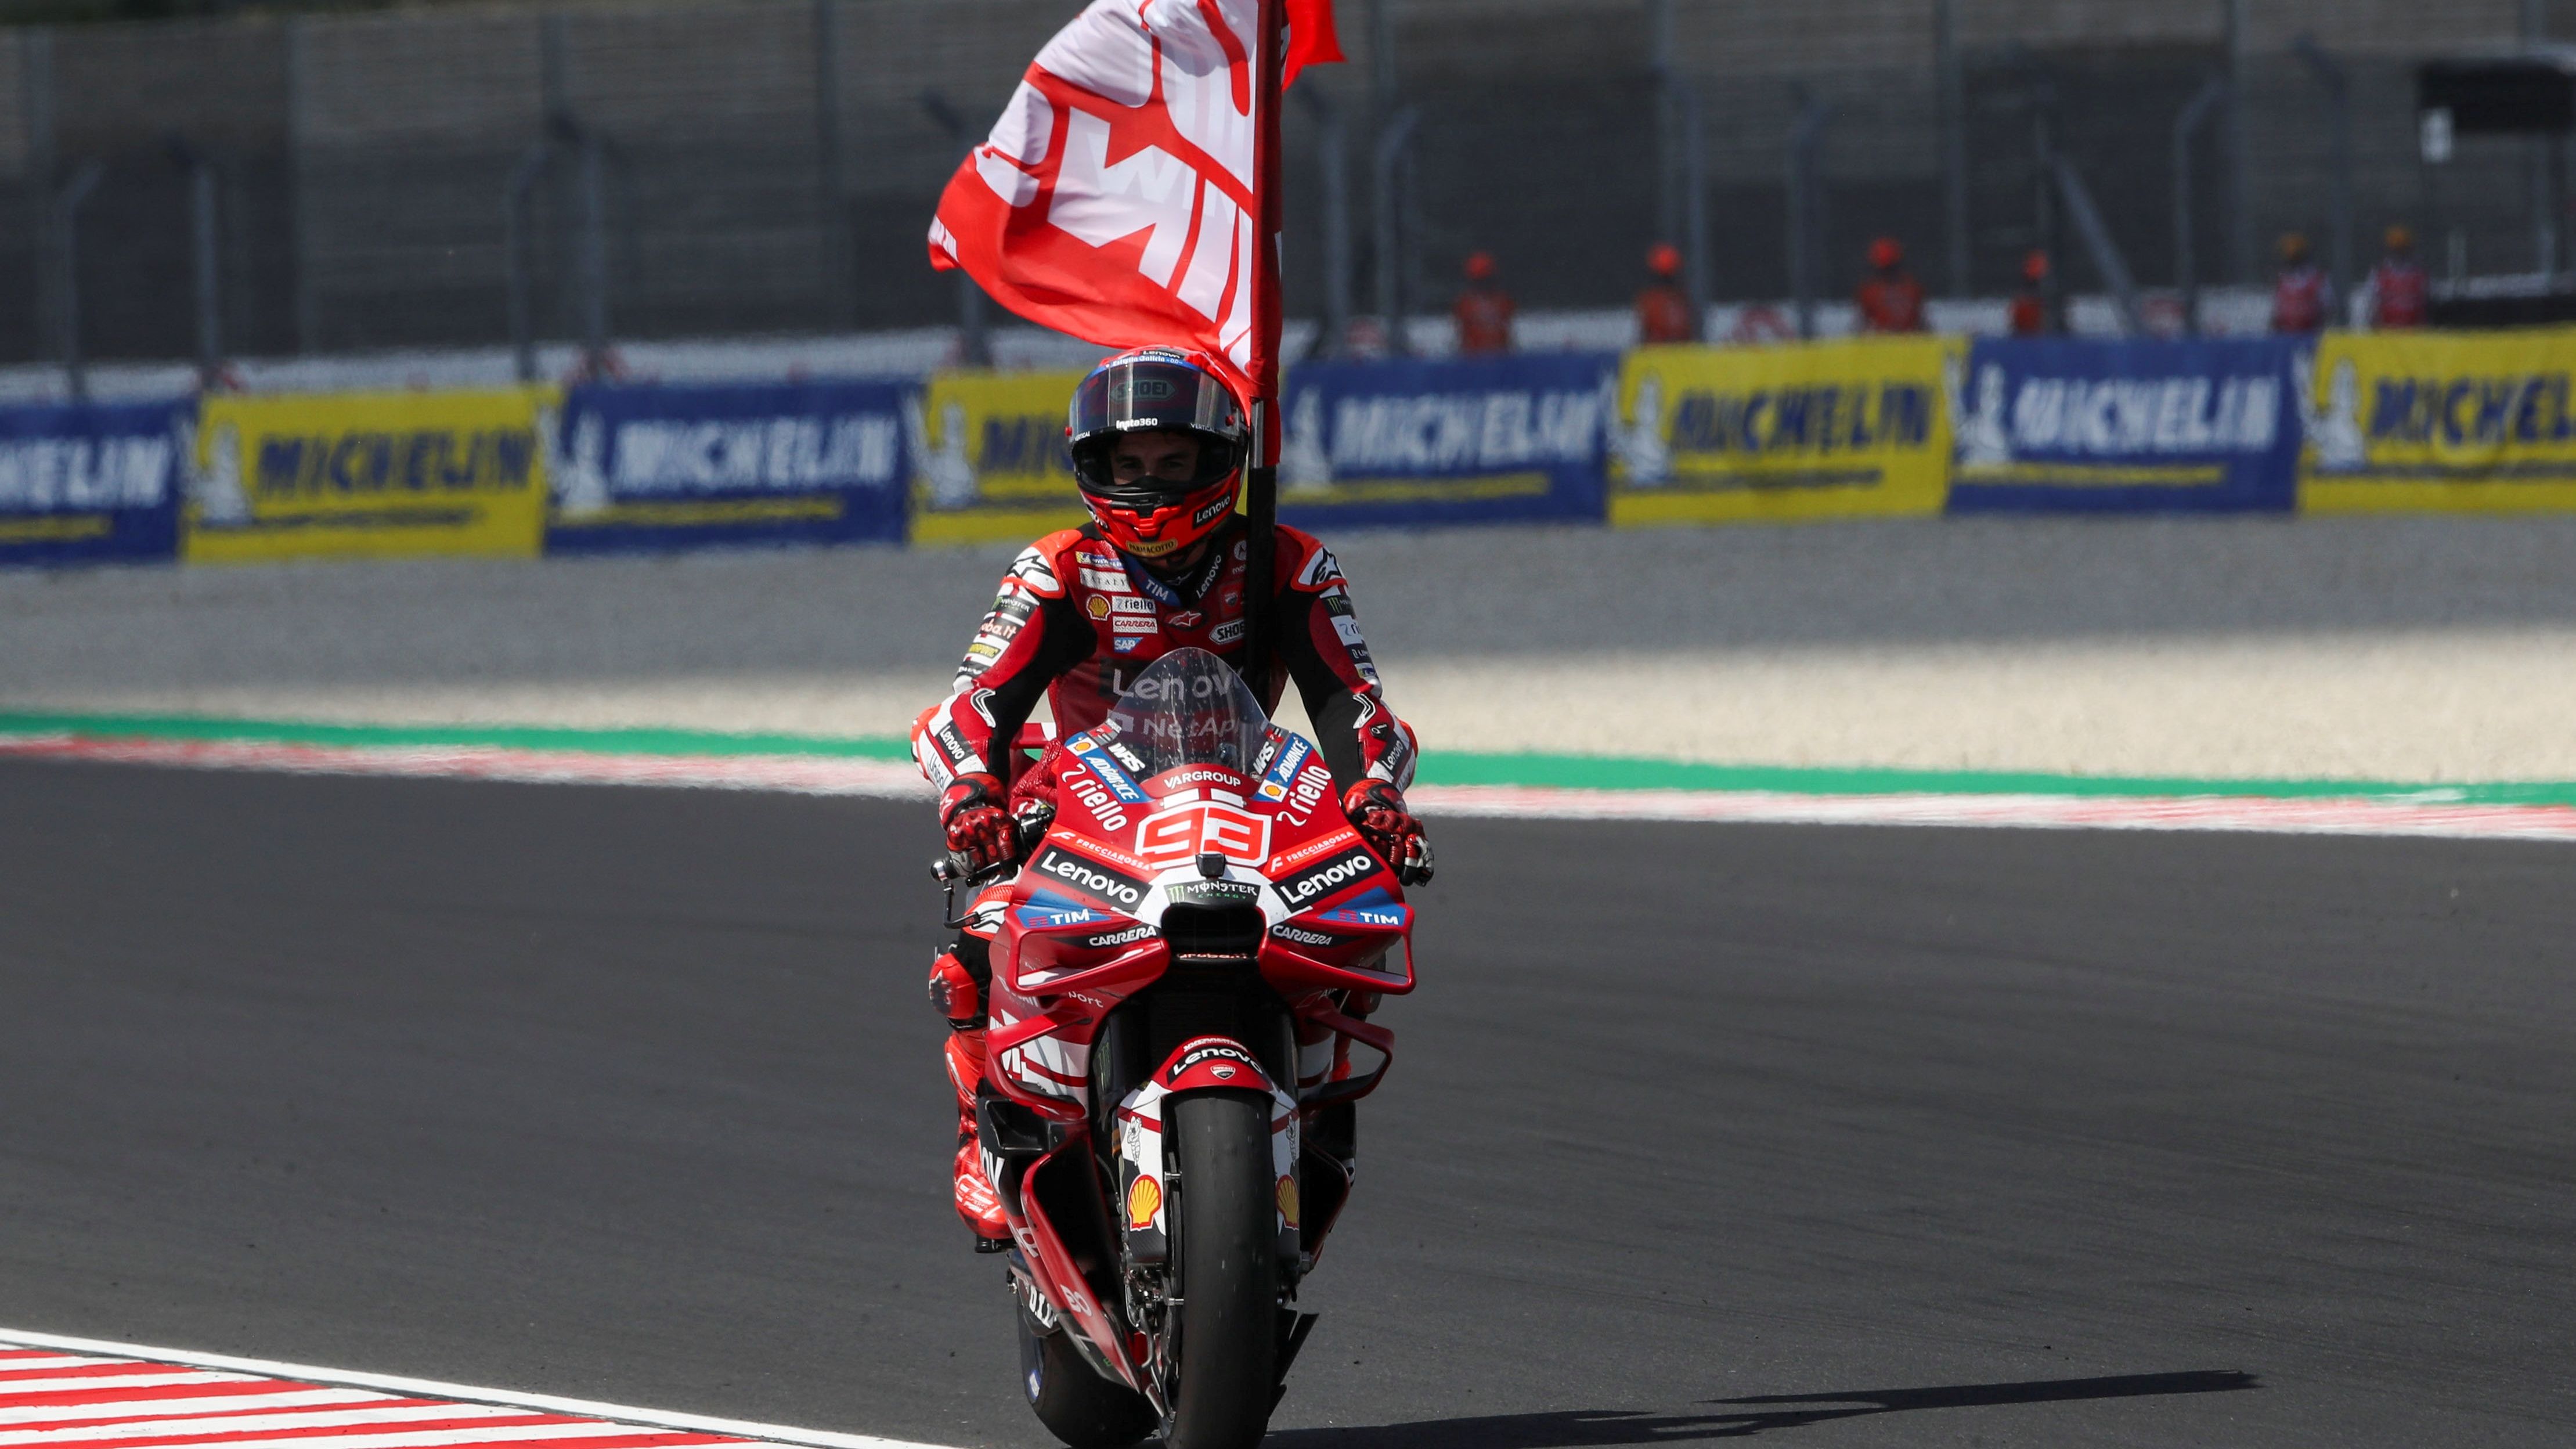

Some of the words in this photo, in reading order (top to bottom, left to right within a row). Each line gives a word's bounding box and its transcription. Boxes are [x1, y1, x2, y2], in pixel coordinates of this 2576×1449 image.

[1116, 417, 1159, 431] Insta360
[1672, 381, 1934, 453] MICHELIN
[2014, 377, 2281, 455] MICHELIN
[2371, 374, 2576, 446] MICHEL
[1190, 422, 1216, 433] VERTICAL
[1330, 390, 1605, 470] MICHELIN
[257, 431, 536, 496] MICHELIN
[614, 414, 901, 495] MICHELIN
[1196, 495, 1231, 524] Lenovo
[1128, 540, 1175, 553] PARMACOTTO
[1145, 579, 1169, 601] TIM
[1196, 554, 1222, 599] Lenovo
[1125, 599, 1154, 610] riello
[1114, 639, 1137, 650] SAP
[1217, 620, 1246, 641] SHOE
[1113, 666, 1243, 700] Lenov
[940, 725, 965, 759] Lenovo
[1143, 716, 1239, 738] NetAp
[1107, 742, 1146, 772] WRS
[1253, 741, 1275, 775] WRS
[1278, 739, 1308, 783] ADVANCE
[1164, 770, 1241, 790] VARGROUP
[1289, 765, 1332, 815] riello
[1069, 778, 1127, 831] riello
[1134, 801, 1272, 871] 93
[1286, 831, 1354, 863] FRECCIAROSSA
[1076, 838, 1150, 871] FRECCIAROSSA
[1041, 851, 1138, 904] Lenovo
[1186, 881, 1258, 896] MONSTER
[1280, 855, 1372, 904] Lenovo
[1050, 909, 1090, 925] TIM
[1360, 911, 1399, 925] TIM
[1088, 925, 1157, 947] CARRERA
[1272, 925, 1333, 946] CARRERA
[1173, 1048, 1263, 1076] Lenovo
